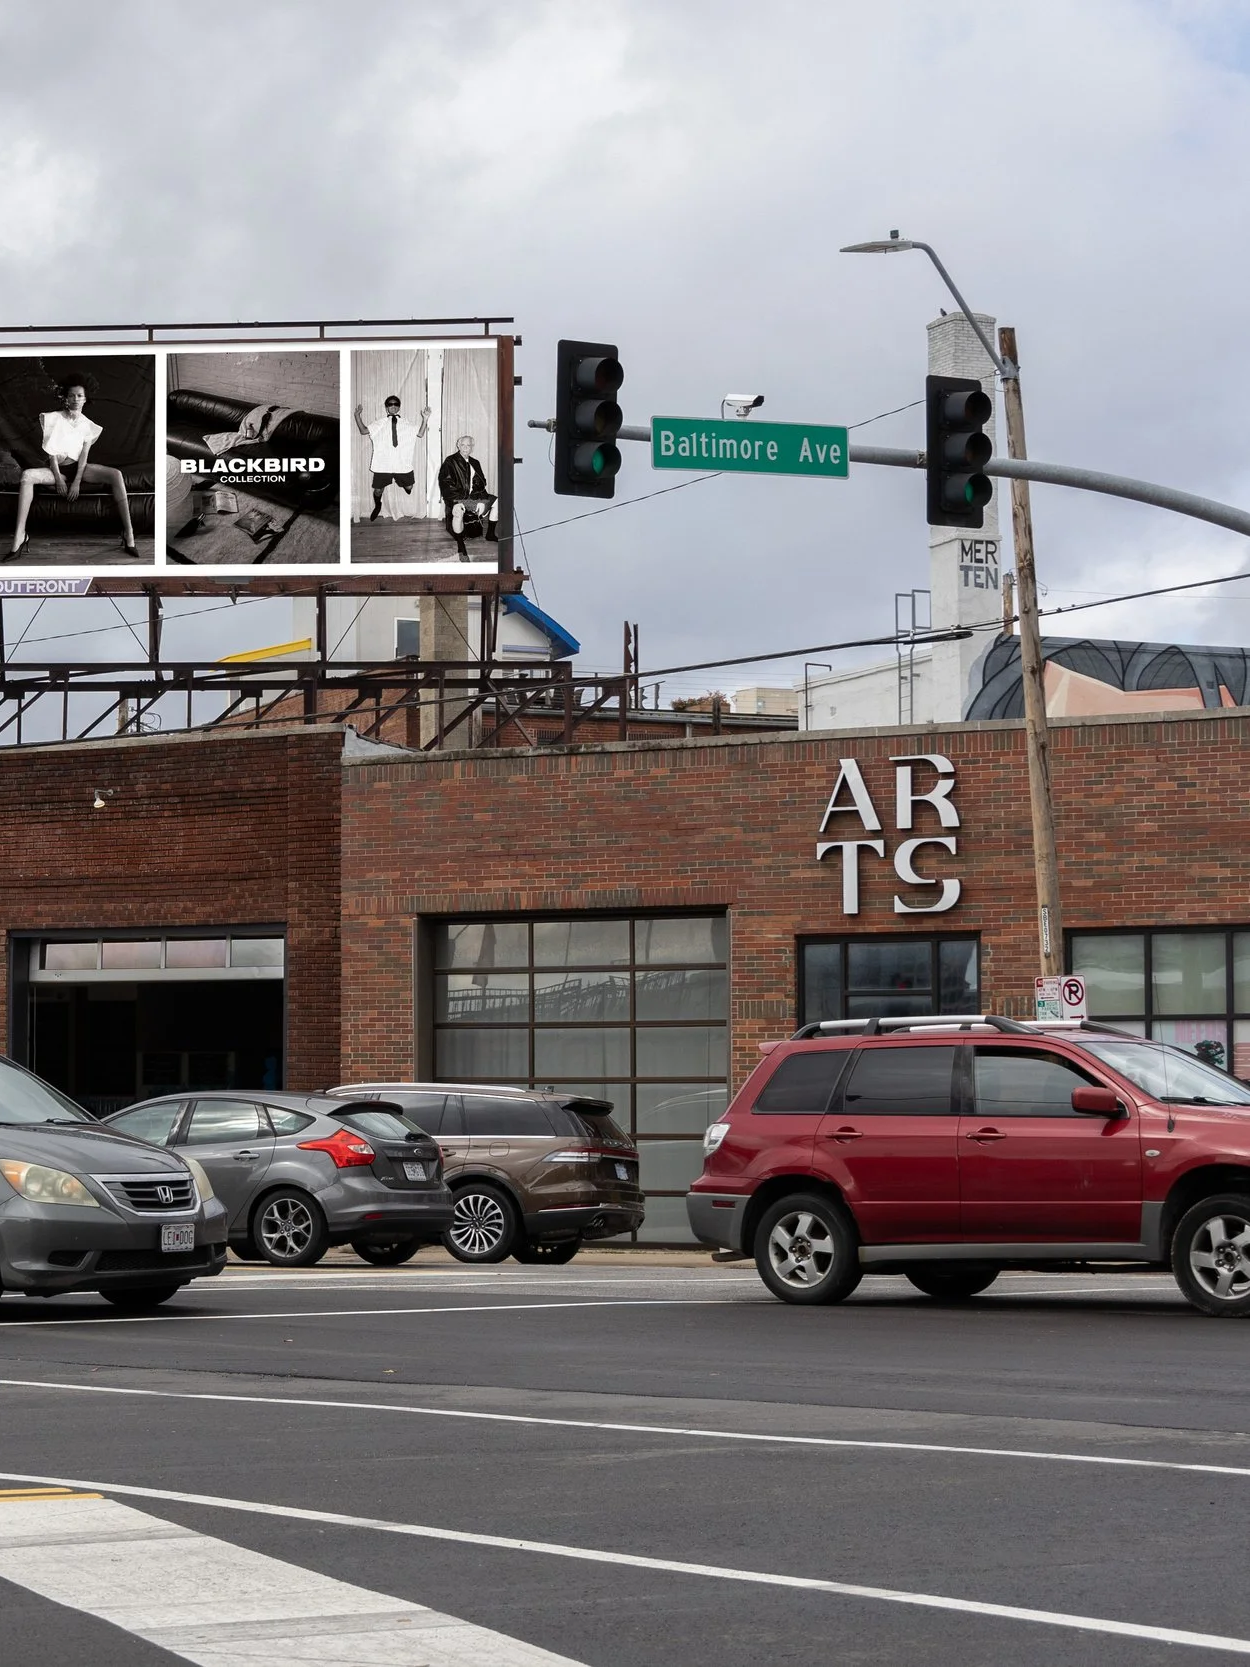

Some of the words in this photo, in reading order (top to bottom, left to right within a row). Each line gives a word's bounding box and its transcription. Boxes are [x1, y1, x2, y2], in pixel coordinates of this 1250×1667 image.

[660, 430, 778, 461] Baltimore
[799, 437, 841, 464] Ave
[180, 457, 325, 474] BLACKBIRD
[219, 475, 286, 483] COLLECTION
[960, 539, 998, 564] MER
[959, 564, 999, 590] TEN
